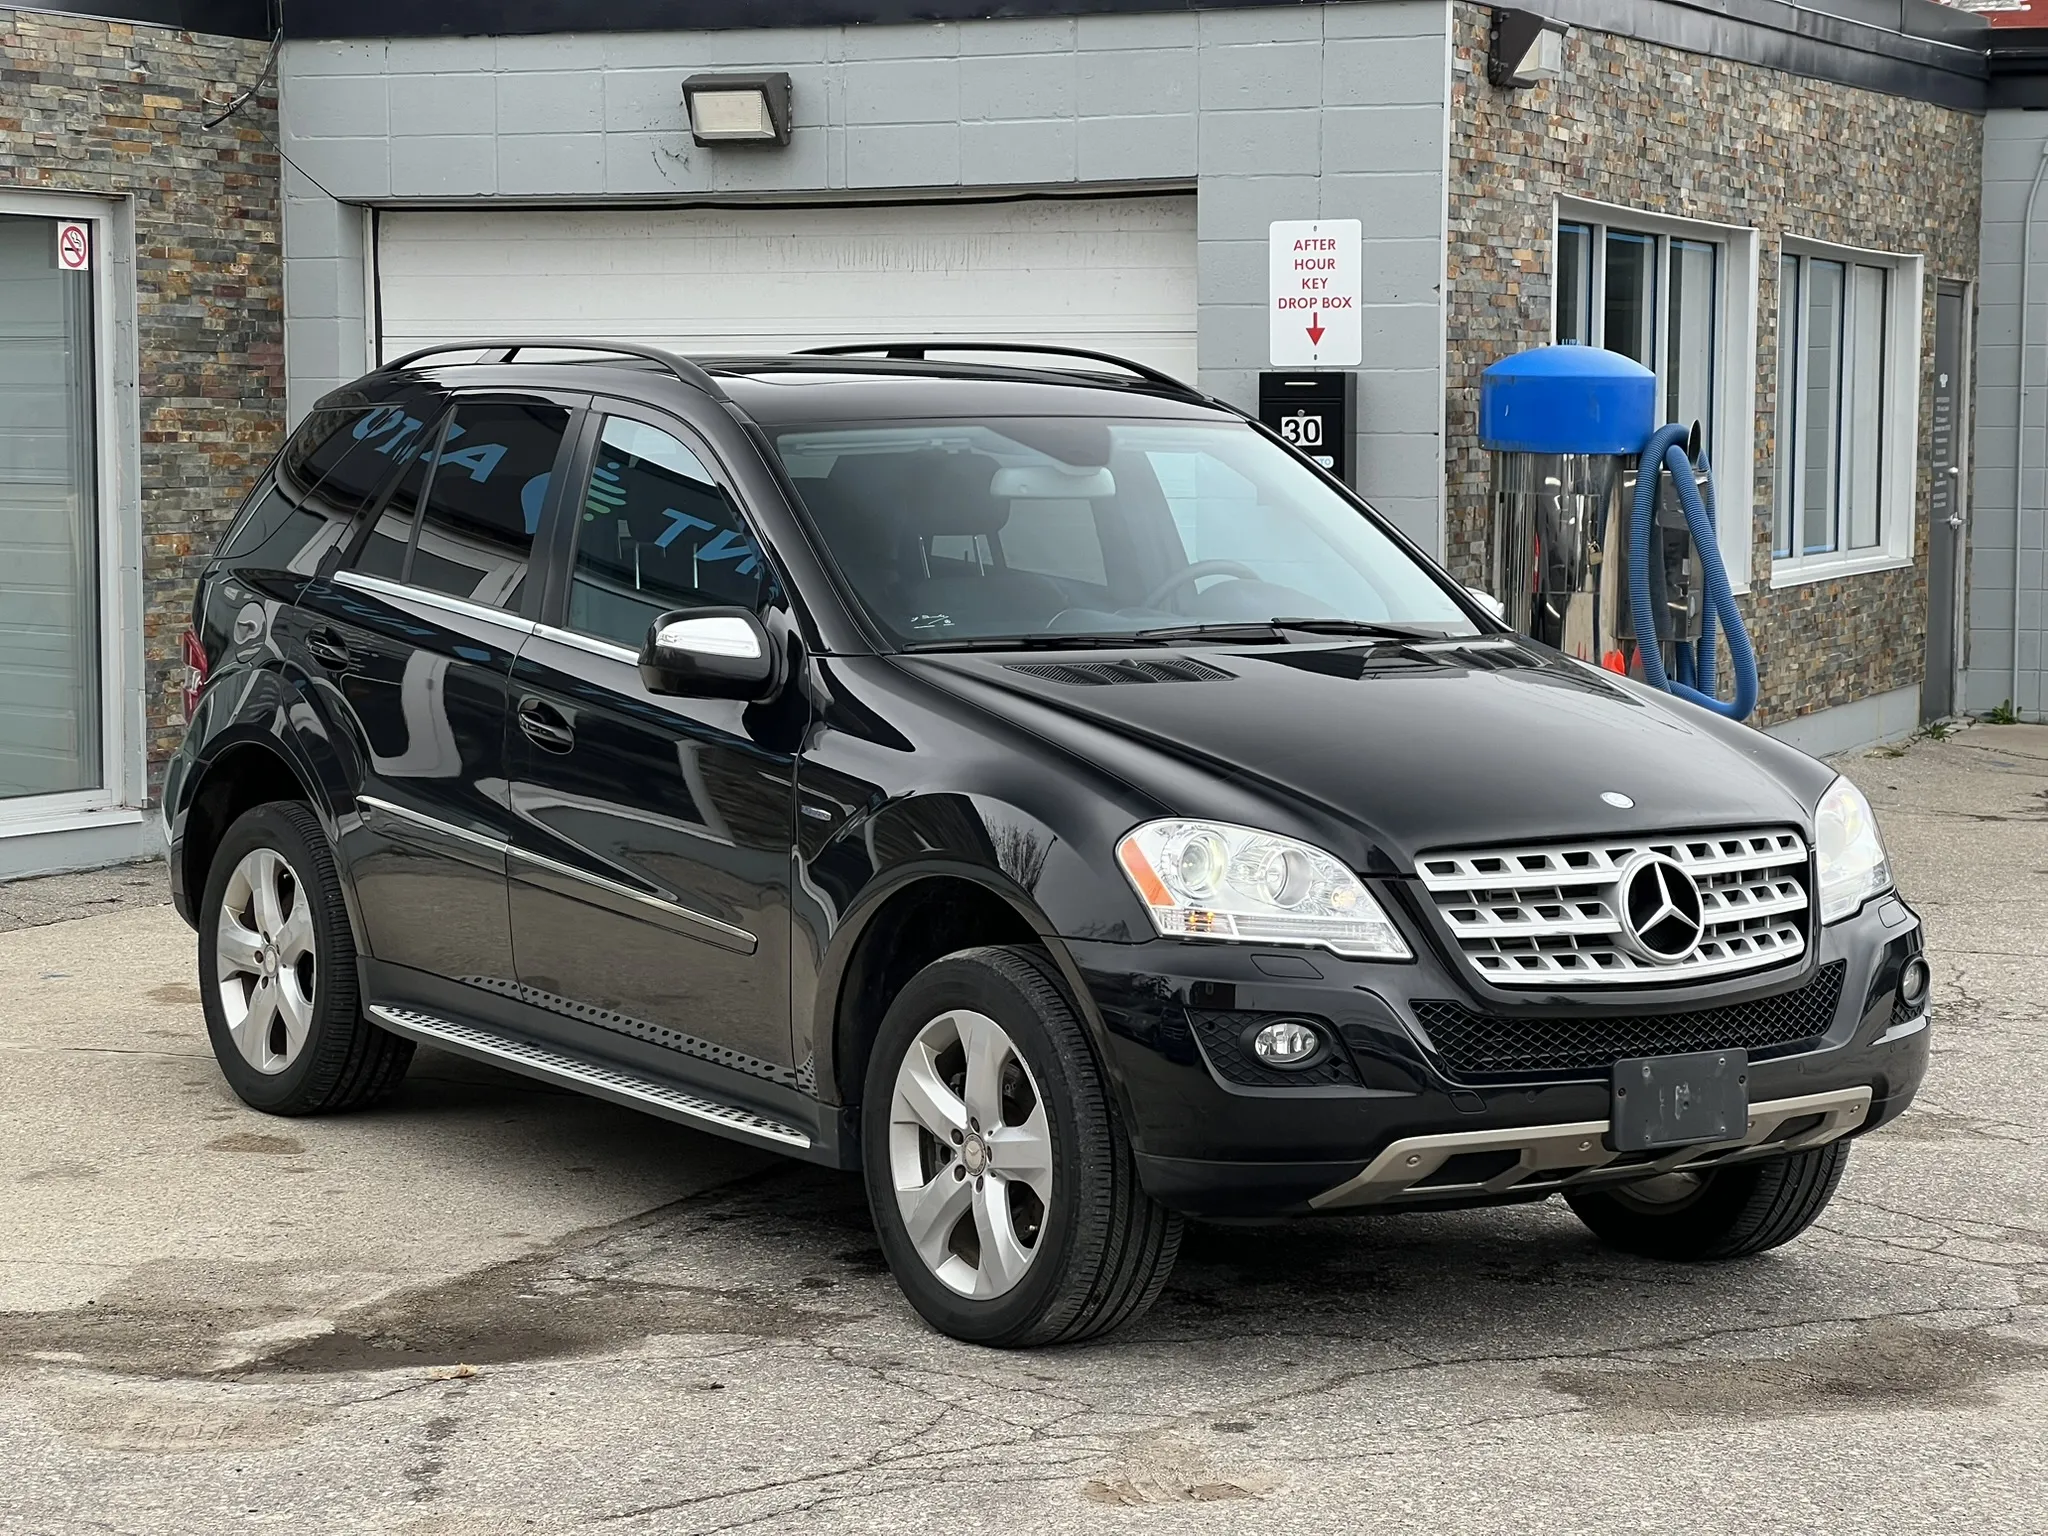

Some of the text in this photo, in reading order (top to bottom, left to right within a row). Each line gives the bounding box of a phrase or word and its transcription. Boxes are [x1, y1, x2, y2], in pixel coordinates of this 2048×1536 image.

[1293, 238, 1336, 251] AFTER
[1294, 258, 1336, 270] HOUR
[1302, 277, 1328, 290] KEY
[1278, 296, 1352, 309] DROP BOX
[1284, 418, 1321, 444] 30
